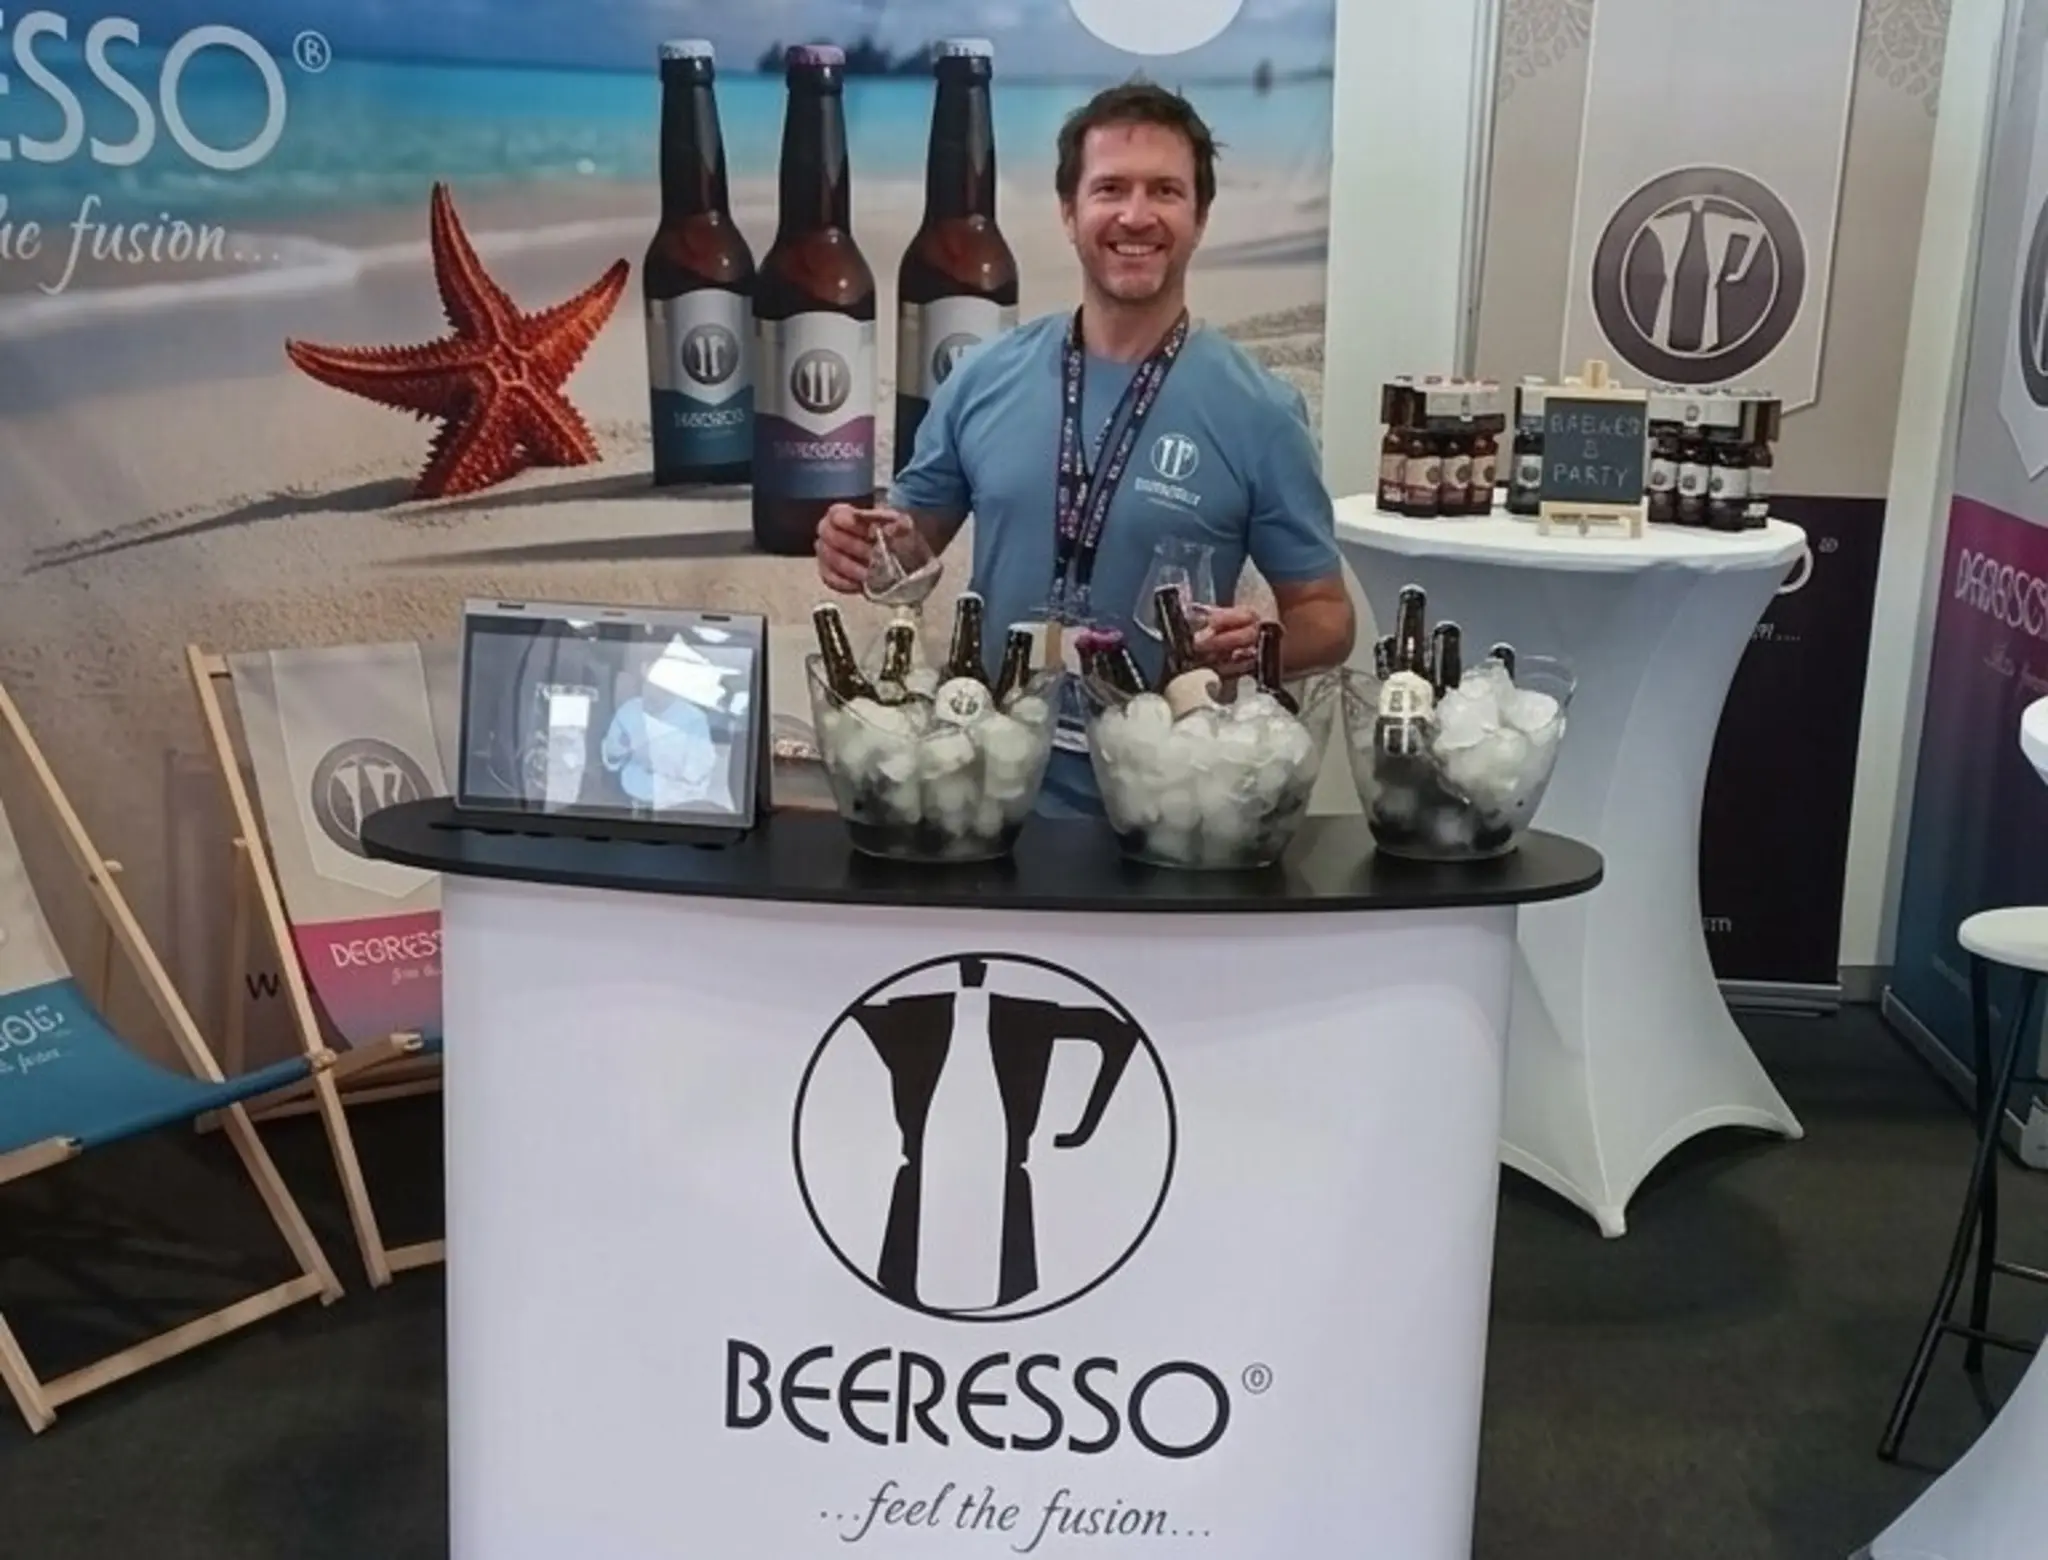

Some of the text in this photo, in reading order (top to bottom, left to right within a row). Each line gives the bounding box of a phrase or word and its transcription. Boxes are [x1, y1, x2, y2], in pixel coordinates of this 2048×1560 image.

[0, 9, 287, 171] SSO
[1553, 462, 1629, 489] PARTY
[724, 1338, 1232, 1460] BEERESSO
[955, 1485, 1021, 1532] the
[1010, 1488, 1211, 1554] fusion...
